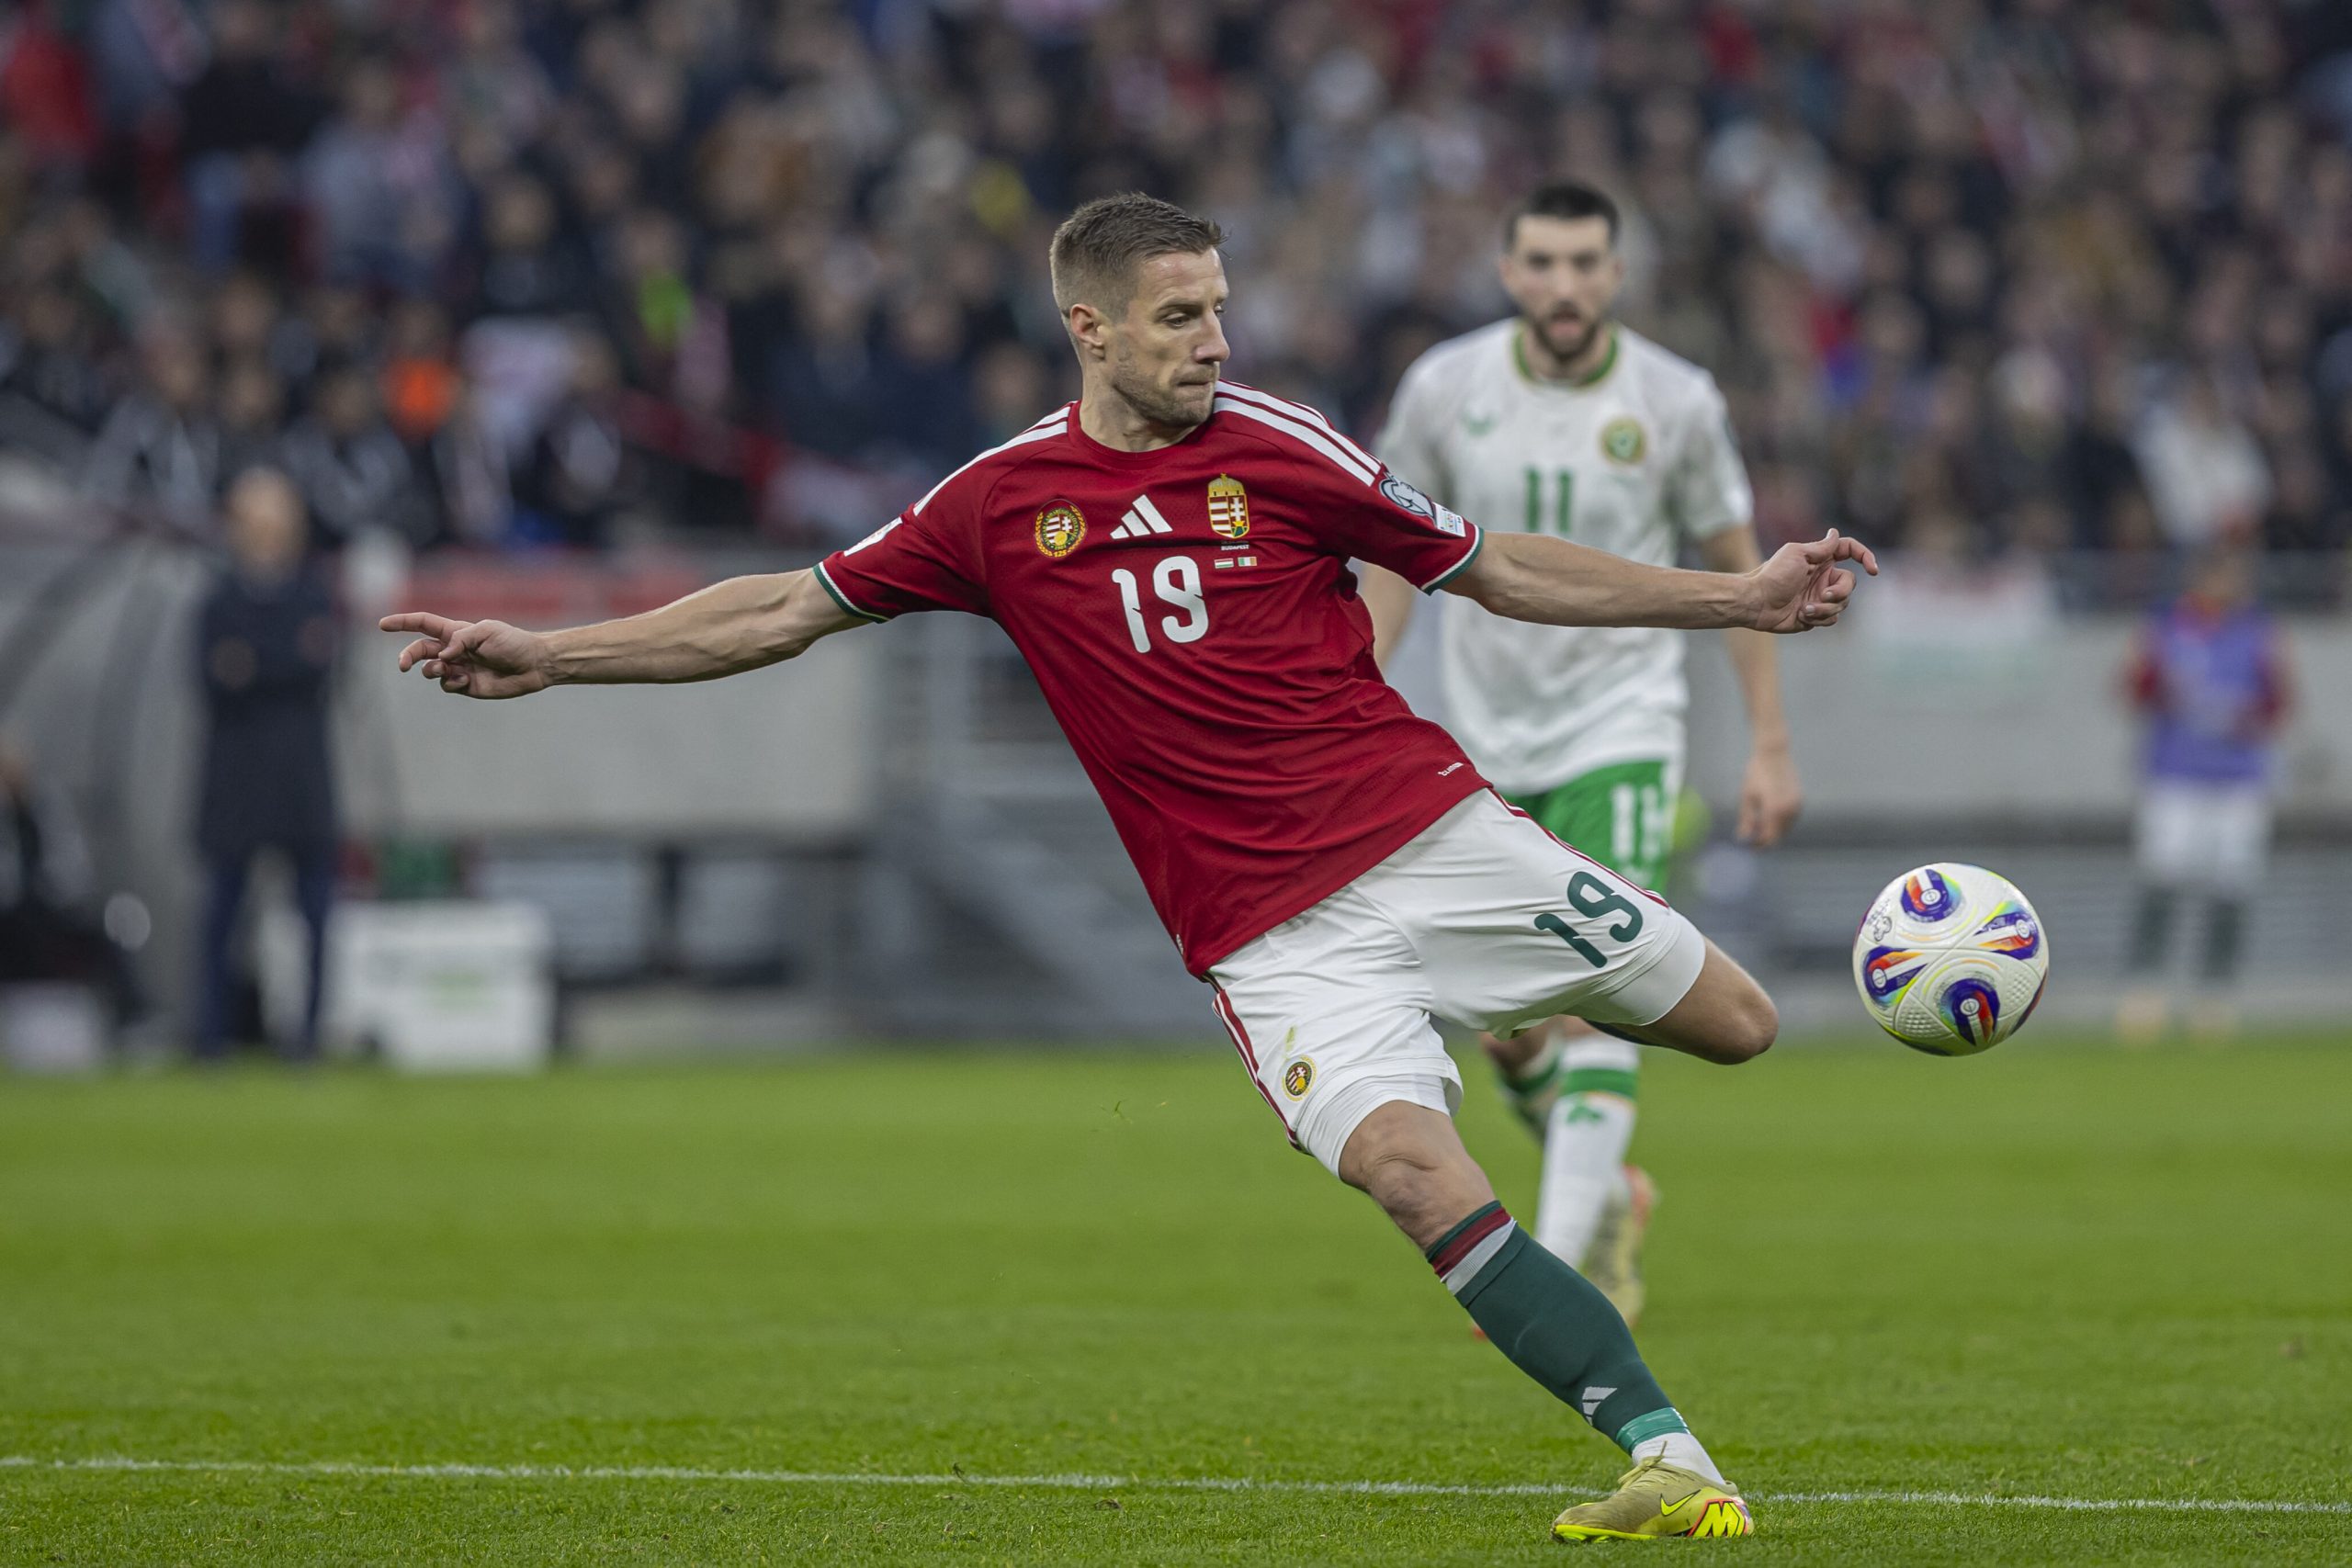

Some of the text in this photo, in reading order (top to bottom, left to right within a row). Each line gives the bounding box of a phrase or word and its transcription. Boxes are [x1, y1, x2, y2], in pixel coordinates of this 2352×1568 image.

[1525, 464, 1572, 533] 11
[1112, 556, 1209, 653] 19
[1534, 871, 1643, 968] 19
